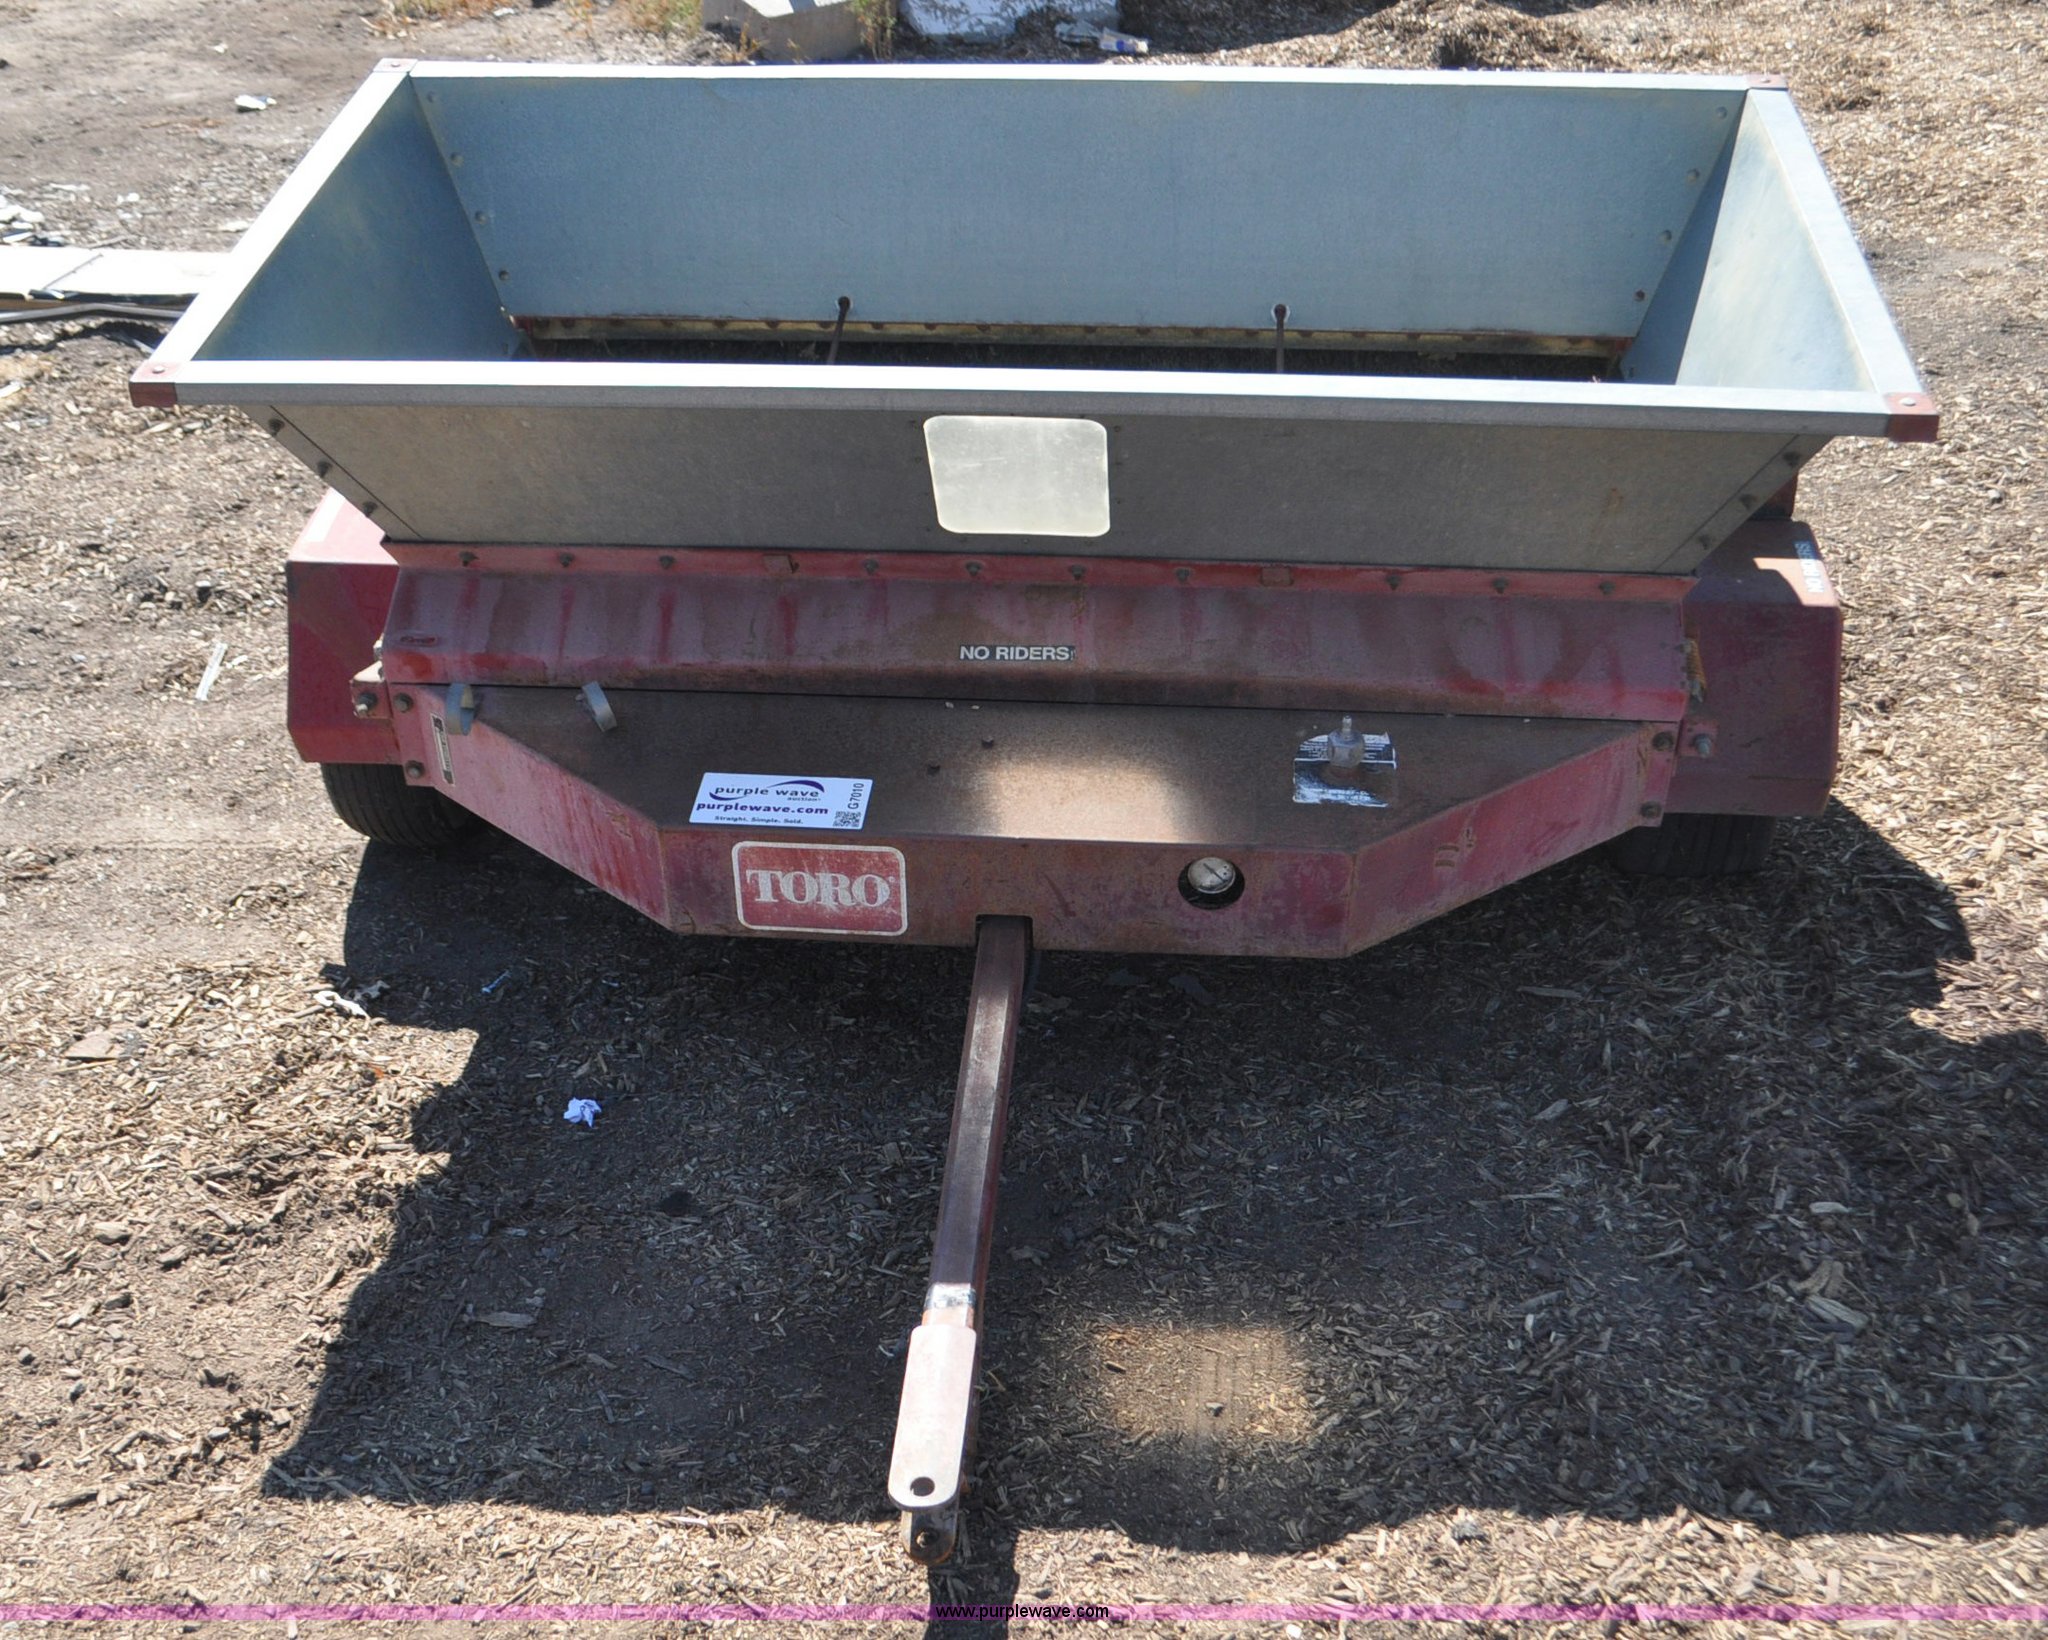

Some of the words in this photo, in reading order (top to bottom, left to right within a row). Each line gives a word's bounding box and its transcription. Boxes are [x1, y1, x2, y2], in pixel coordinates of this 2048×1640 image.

[960, 646, 990, 660] NO
[996, 646, 1070, 660] RIDERS
[715, 787, 769, 796] purple
[776, 789, 819, 797] wave
[847, 783, 865, 810] G7010
[696, 803, 828, 815] purplewave.com
[746, 870, 890, 907] TORO
